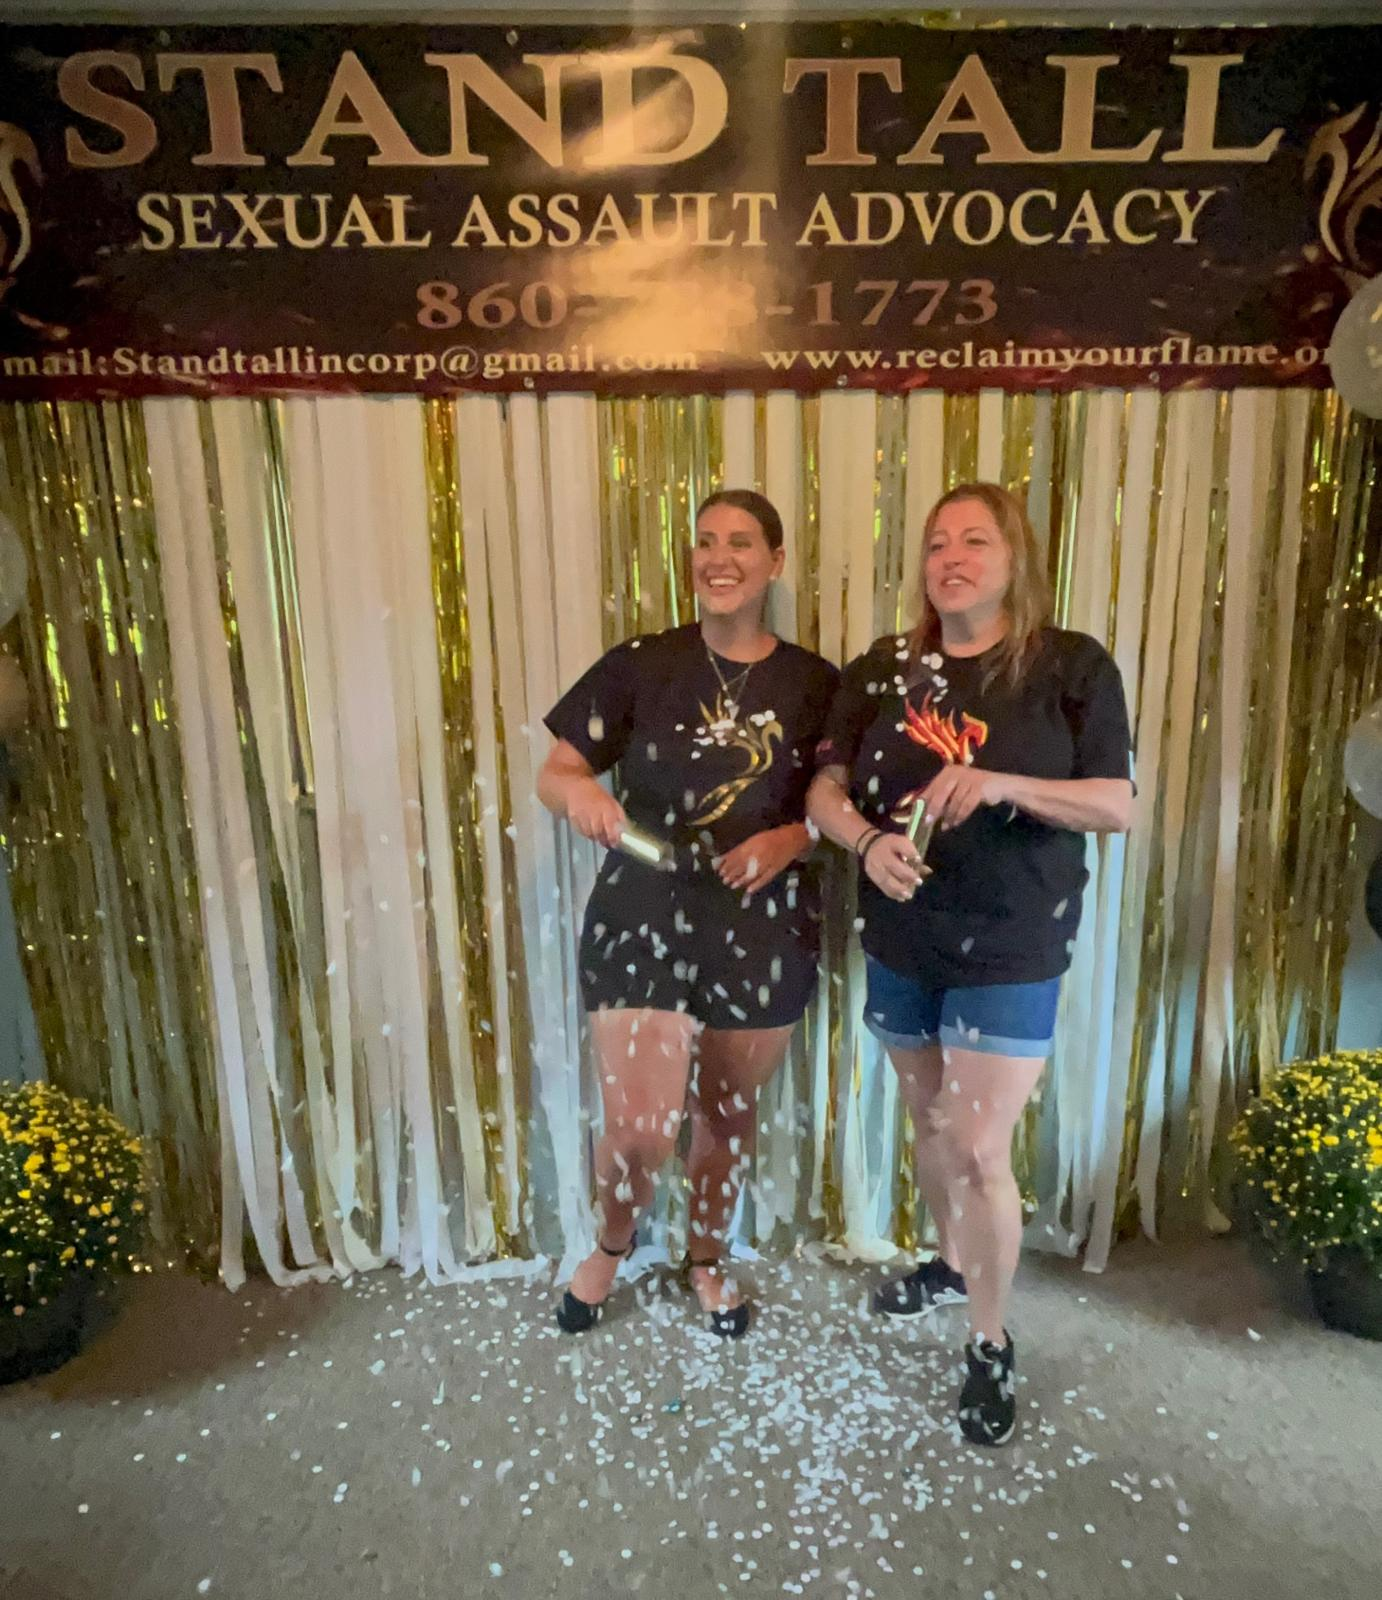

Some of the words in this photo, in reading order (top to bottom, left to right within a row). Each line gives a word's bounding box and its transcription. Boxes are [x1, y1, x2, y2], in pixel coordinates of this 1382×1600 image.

[57, 50, 729, 168] STAND
[783, 54, 1285, 164] TALL
[137, 193, 430, 250] SEXUAL
[451, 192, 777, 249] ASSAULT
[796, 189, 1216, 246] ADVOCACY
[416, 278, 998, 329] 860--1773
